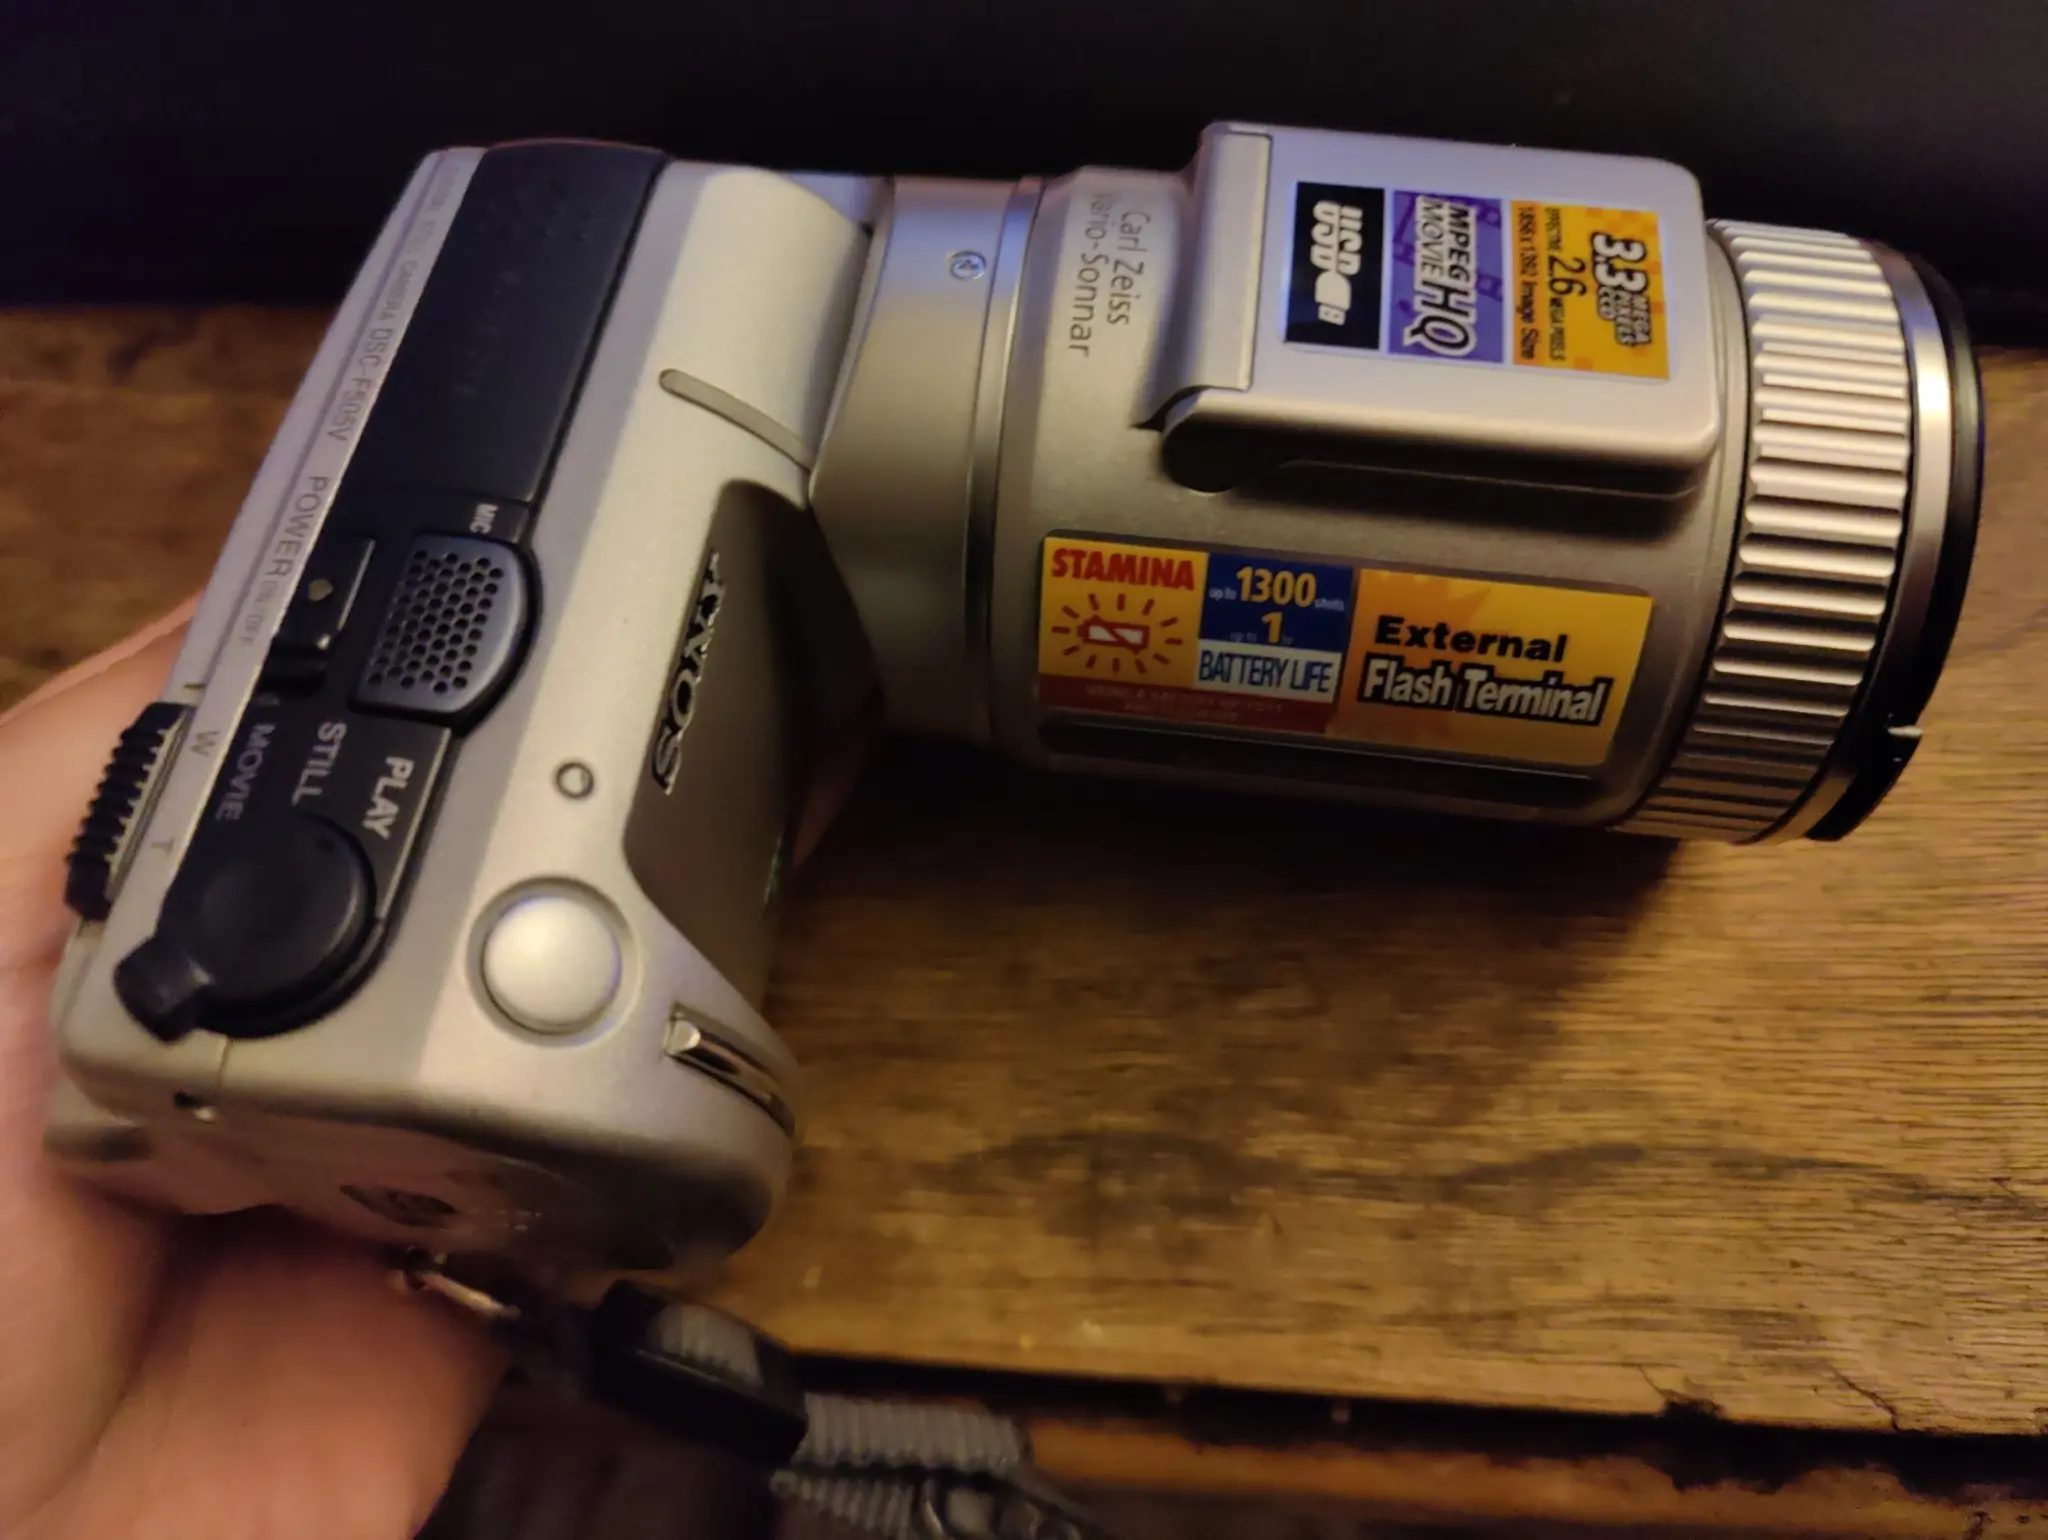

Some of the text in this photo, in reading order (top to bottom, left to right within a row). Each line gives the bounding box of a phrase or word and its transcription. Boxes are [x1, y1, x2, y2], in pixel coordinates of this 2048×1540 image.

[1421, 197, 1445, 278] MOVIE
[1449, 203, 1471, 283] MPEG
[1590, 232, 1647, 294] 3.3
[1106, 210, 1152, 326] Carl Zeiss
[1409, 280, 1471, 351] HQ
[1517, 280, 1538, 324] Image
[1598, 286, 1616, 321] CCD
[1615, 287, 1634, 346] PIXELS
[1631, 293, 1651, 343] MEGA
[1519, 327, 1539, 361] Size
[327, 328, 394, 442] DSC-F505V
[264, 475, 332, 578] POWER
[469, 503, 498, 534] MIC
[1051, 547, 1195, 591] STAMINA
[1236, 565, 1318, 608] 1300
[1261, 611, 1284, 644] 1
[1374, 614, 1569, 663] External
[652, 552, 726, 797] SONY
[1199, 651, 1333, 693] BATTERY LIFE
[1360, 654, 1610, 724] Flash Terminal
[189, 730, 221, 758] W
[215, 723, 276, 822] MOVIE
[292, 722, 347, 807] STILL
[361, 756, 416, 841] PLAY
